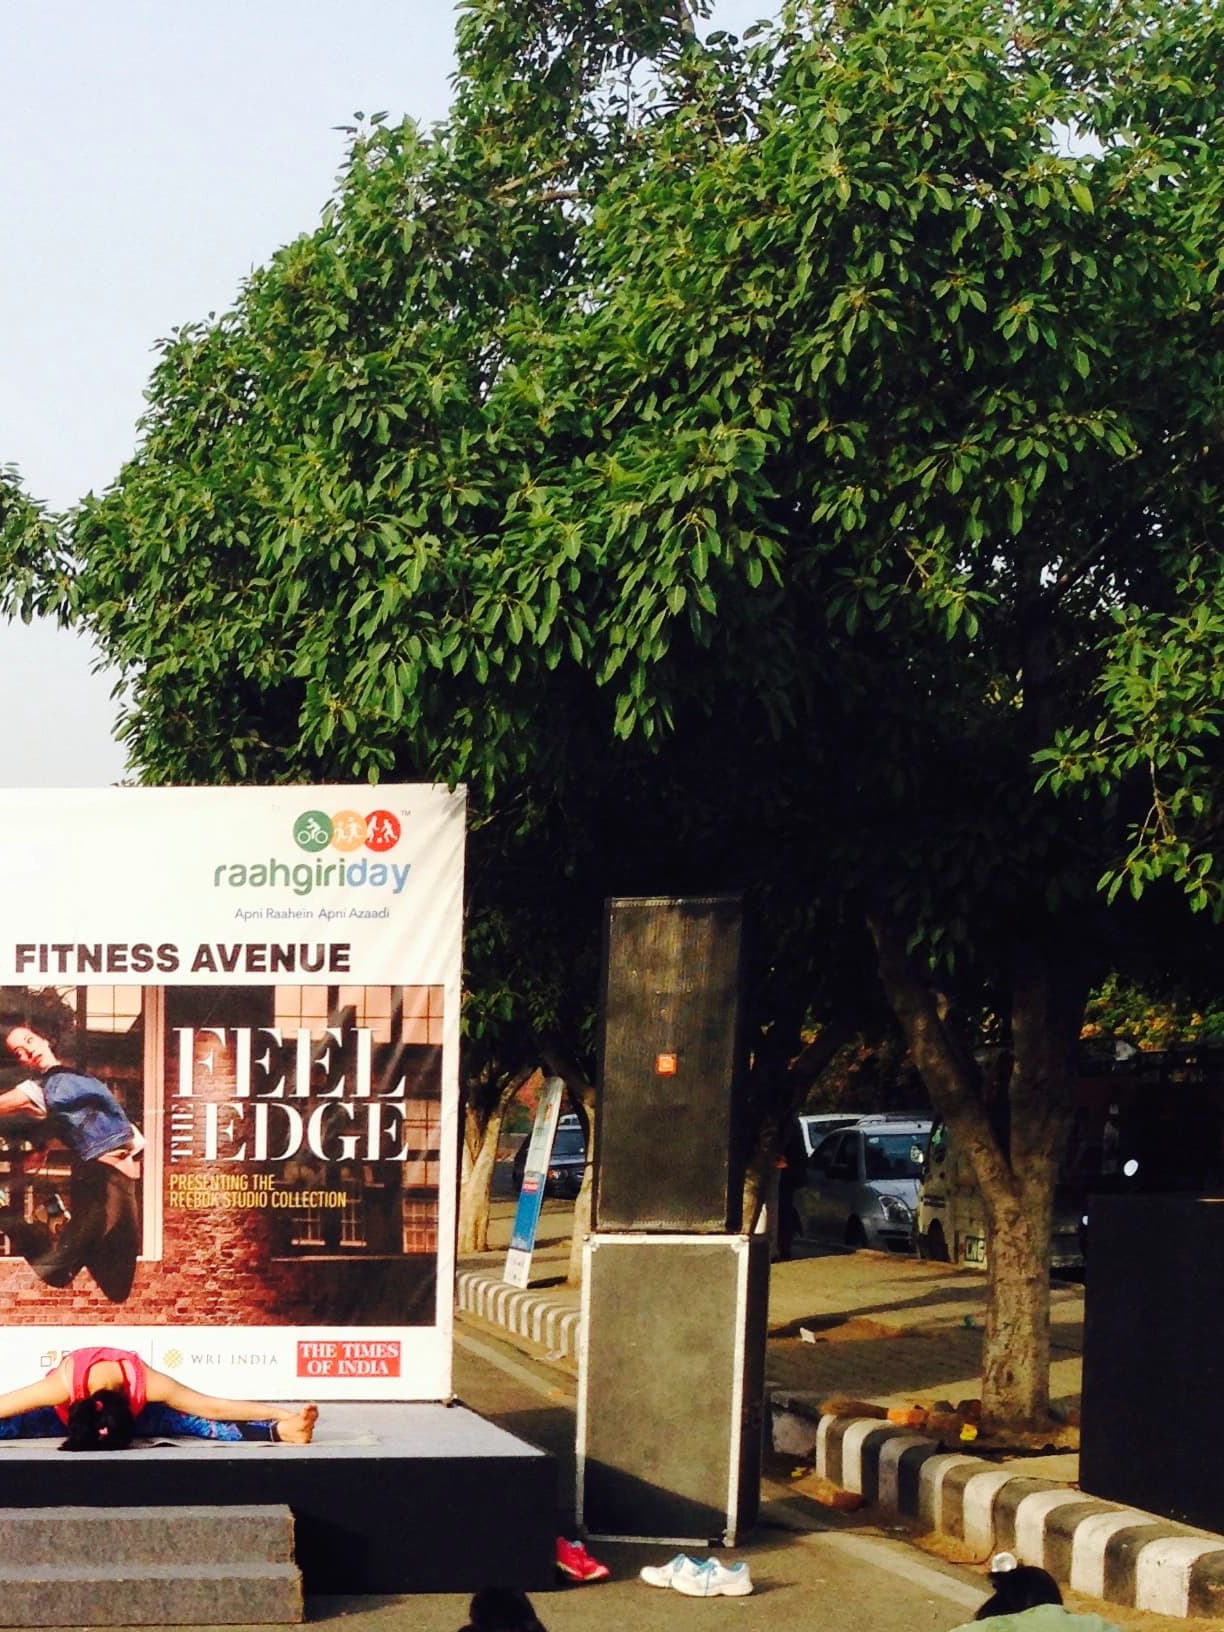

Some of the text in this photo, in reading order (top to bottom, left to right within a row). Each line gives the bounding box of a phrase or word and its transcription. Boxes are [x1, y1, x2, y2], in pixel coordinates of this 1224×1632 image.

[213, 857, 412, 896] raahgiriday
[234, 906, 390, 921] Apni Raahein Apni Azaadi
[15, 943, 180, 973] FITNESS
[190, 943, 351, 973] AVENUE
[172, 1027, 407, 1098] FEEL
[200, 1102, 409, 1161] EDGE
[170, 1174, 276, 1191] PRESENTING THE
[169, 1191, 347, 1208] REEBOK STUDIO COLLECTION
[191, 1353, 278, 1365] WRI INDIA
[300, 1343, 399, 1358] THE TIMES
[307, 1360, 389, 1375] OF INDIA
